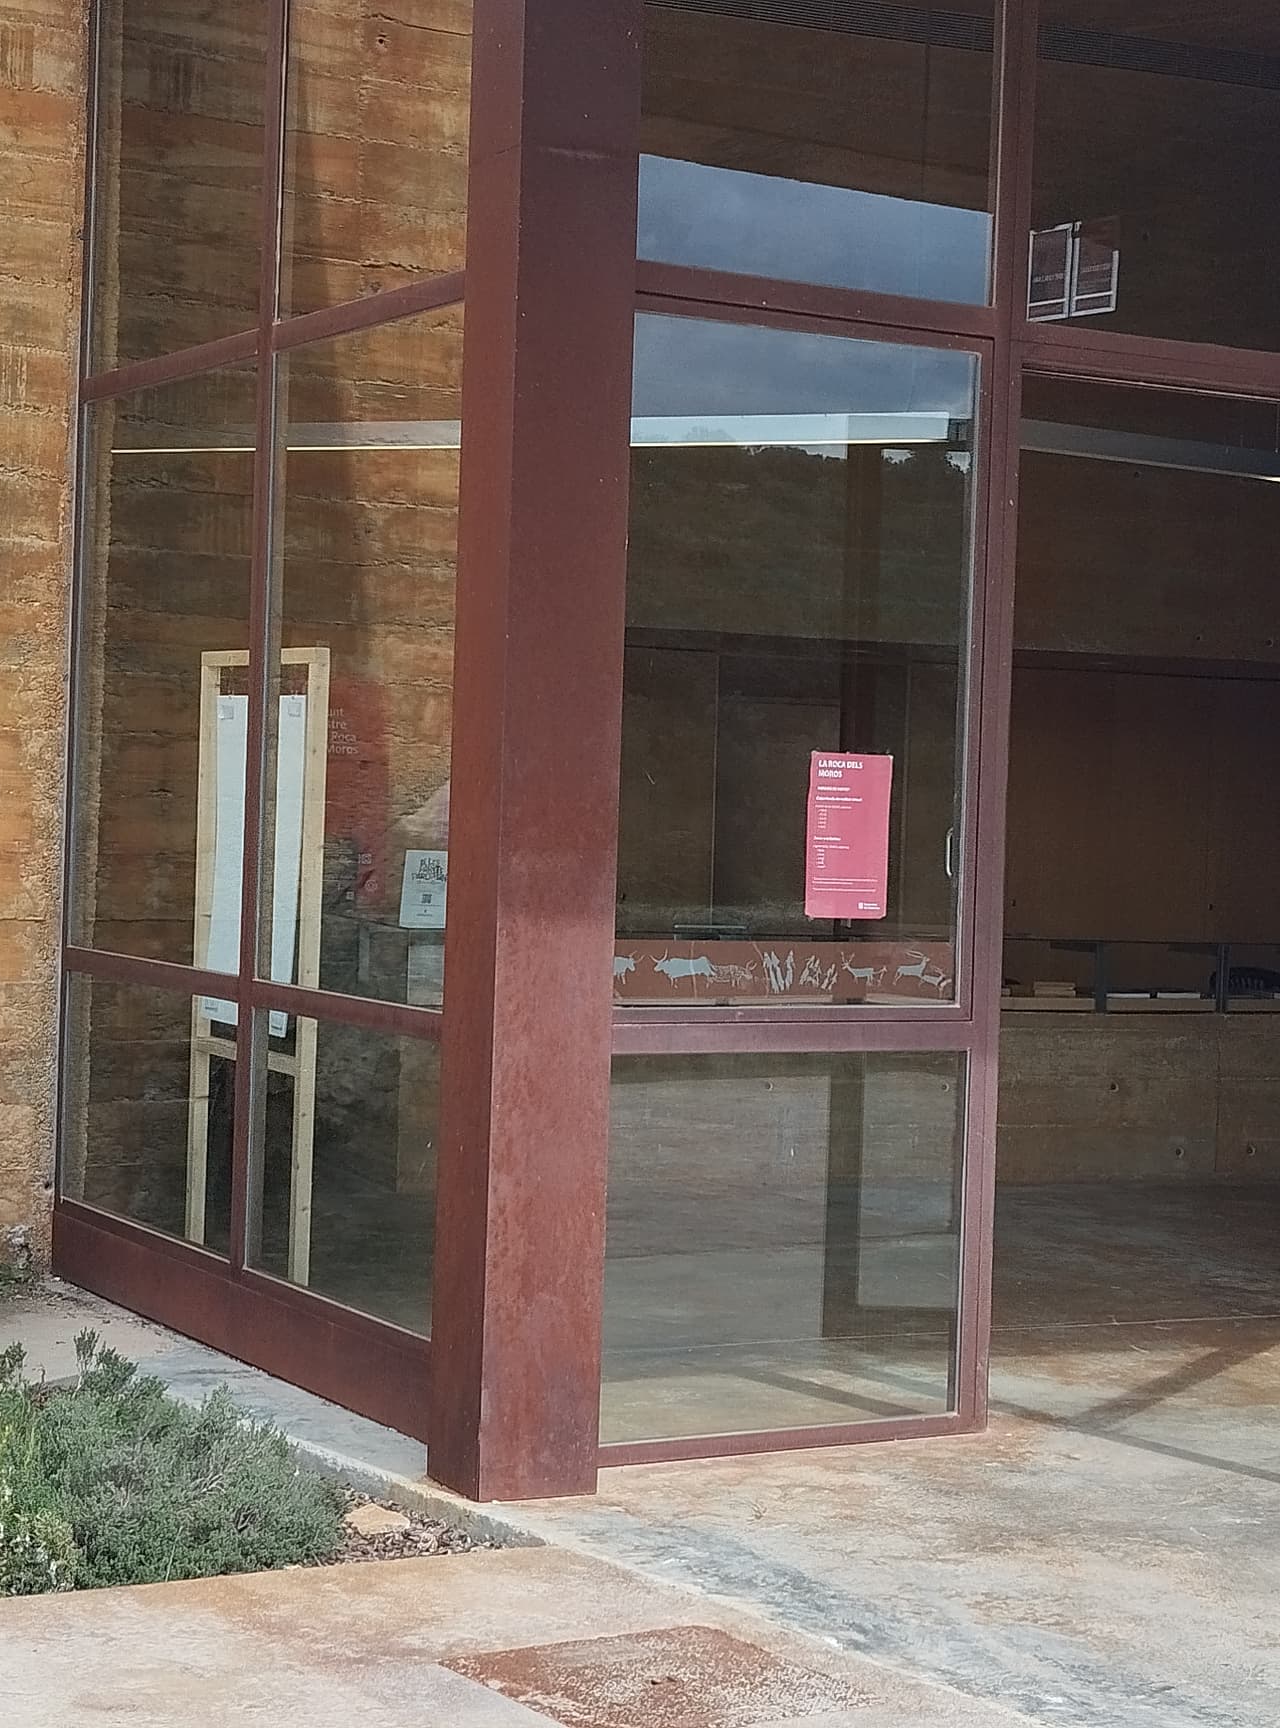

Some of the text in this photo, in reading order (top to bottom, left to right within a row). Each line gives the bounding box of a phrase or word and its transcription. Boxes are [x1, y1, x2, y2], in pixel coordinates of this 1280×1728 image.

[828, 760, 846, 769] ROCA
[847, 761, 863, 769] DELS
[818, 769, 843, 778] MOROS
